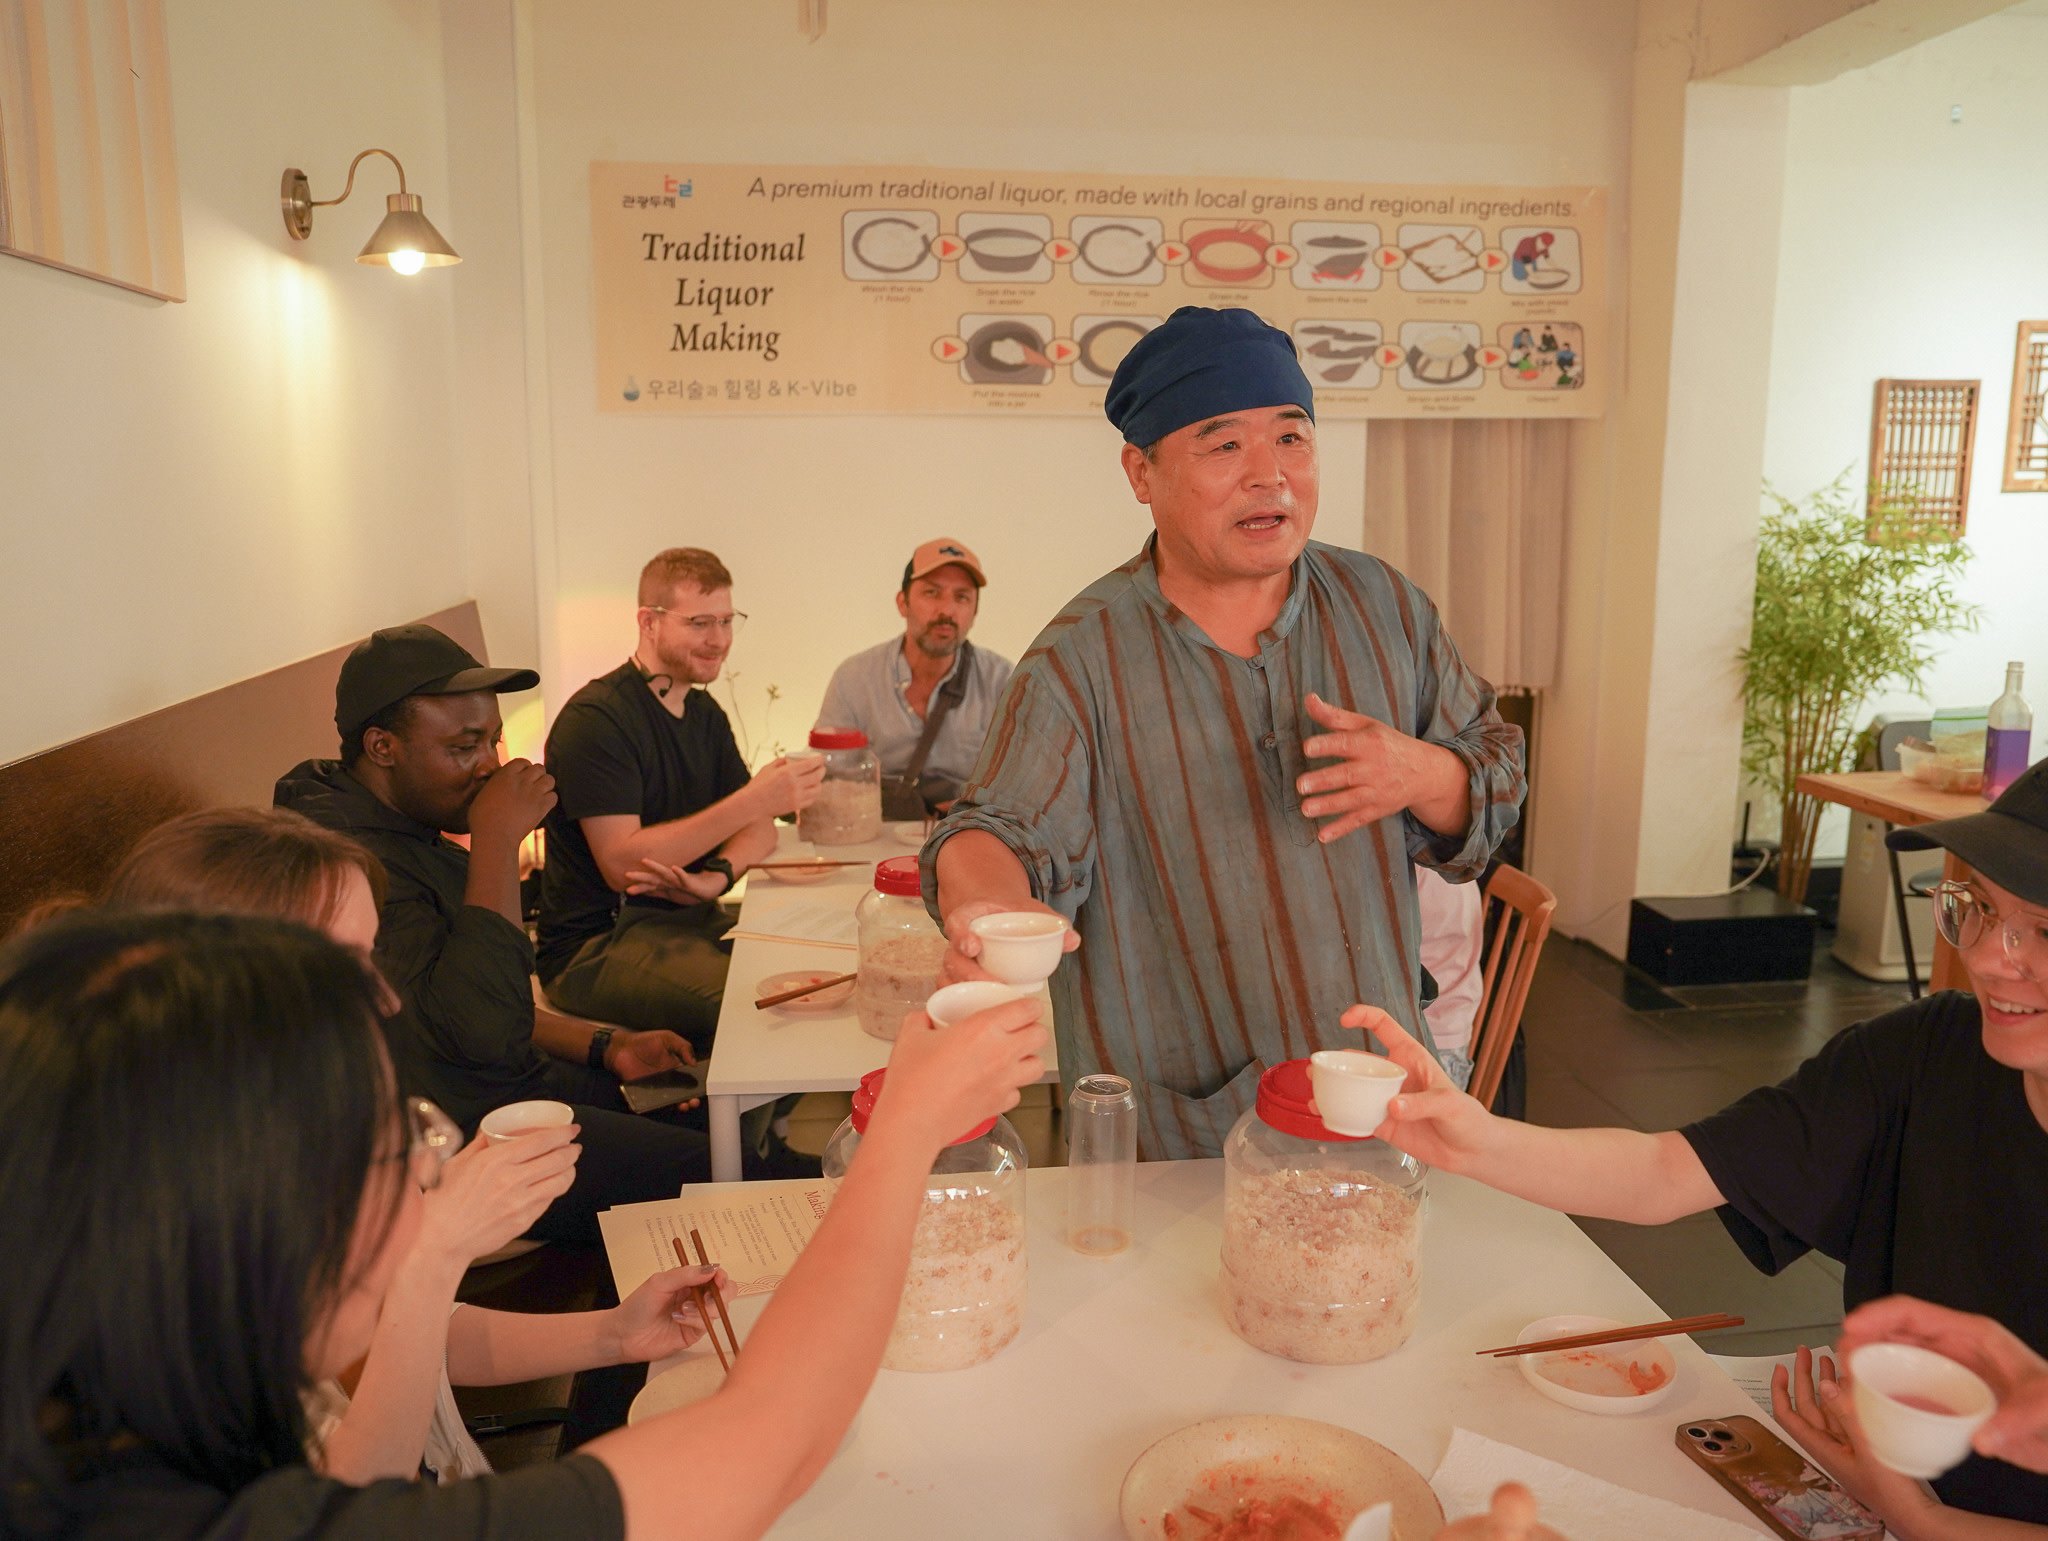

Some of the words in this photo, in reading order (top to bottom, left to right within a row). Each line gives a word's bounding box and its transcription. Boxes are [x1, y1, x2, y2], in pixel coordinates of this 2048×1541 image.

[622, 195, 676, 209] 관광두레
[747, 177, 766, 197] A
[771, 179, 873, 202] premium
[880, 178, 995, 200] traditional
[1000, 182, 1067, 207] liquor,
[1075, 185, 1137, 206] made
[1141, 187, 1190, 208] with
[1195, 188, 1247, 209] local
[1251, 190, 1319, 214] grains
[1324, 193, 1365, 213] and
[1369, 195, 1455, 218] regional
[1459, 197, 1577, 221] ingredients.
[642, 232, 806, 262] Traditional
[674, 278, 774, 316] Liquor
[670, 321, 782, 362] Making
[647, 379, 718, 400] 우리술과
[725, 379, 761, 400] 힐링
[768, 380, 781, 397] &
[787, 379, 858, 397] K-Vibe
[804, 1190, 826, 1220] Making
